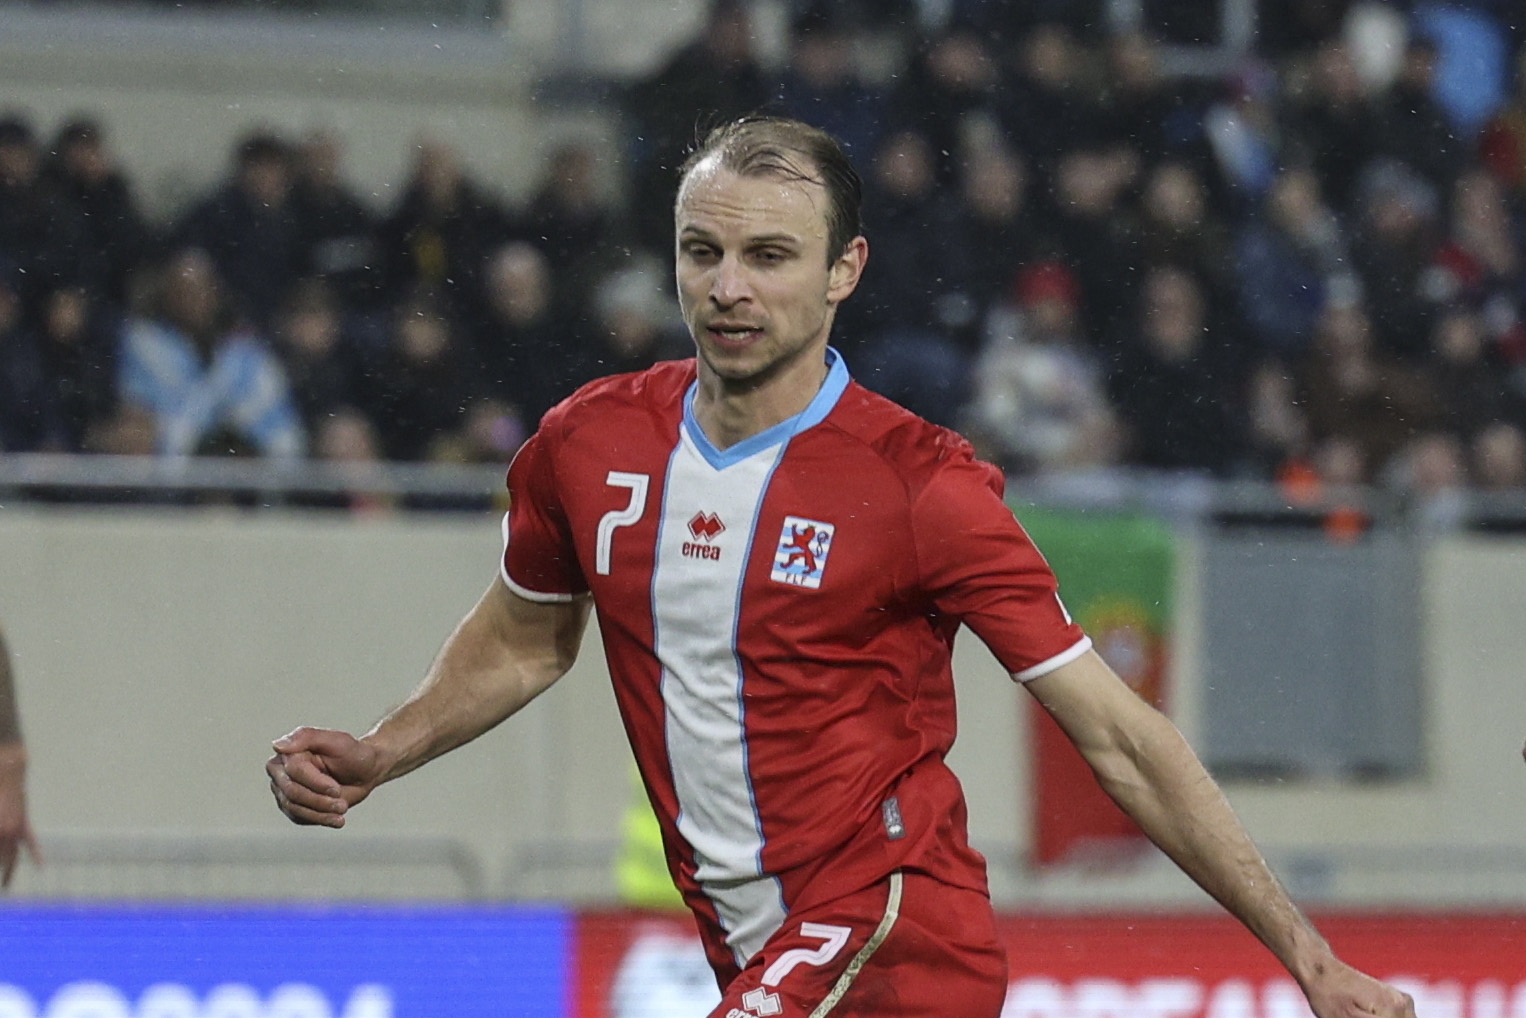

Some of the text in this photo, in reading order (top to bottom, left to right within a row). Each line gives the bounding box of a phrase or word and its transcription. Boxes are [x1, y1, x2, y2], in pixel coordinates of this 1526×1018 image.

[596, 471, 650, 575] 7
[682, 541, 721, 561] errea
[761, 922, 852, 987] 7
